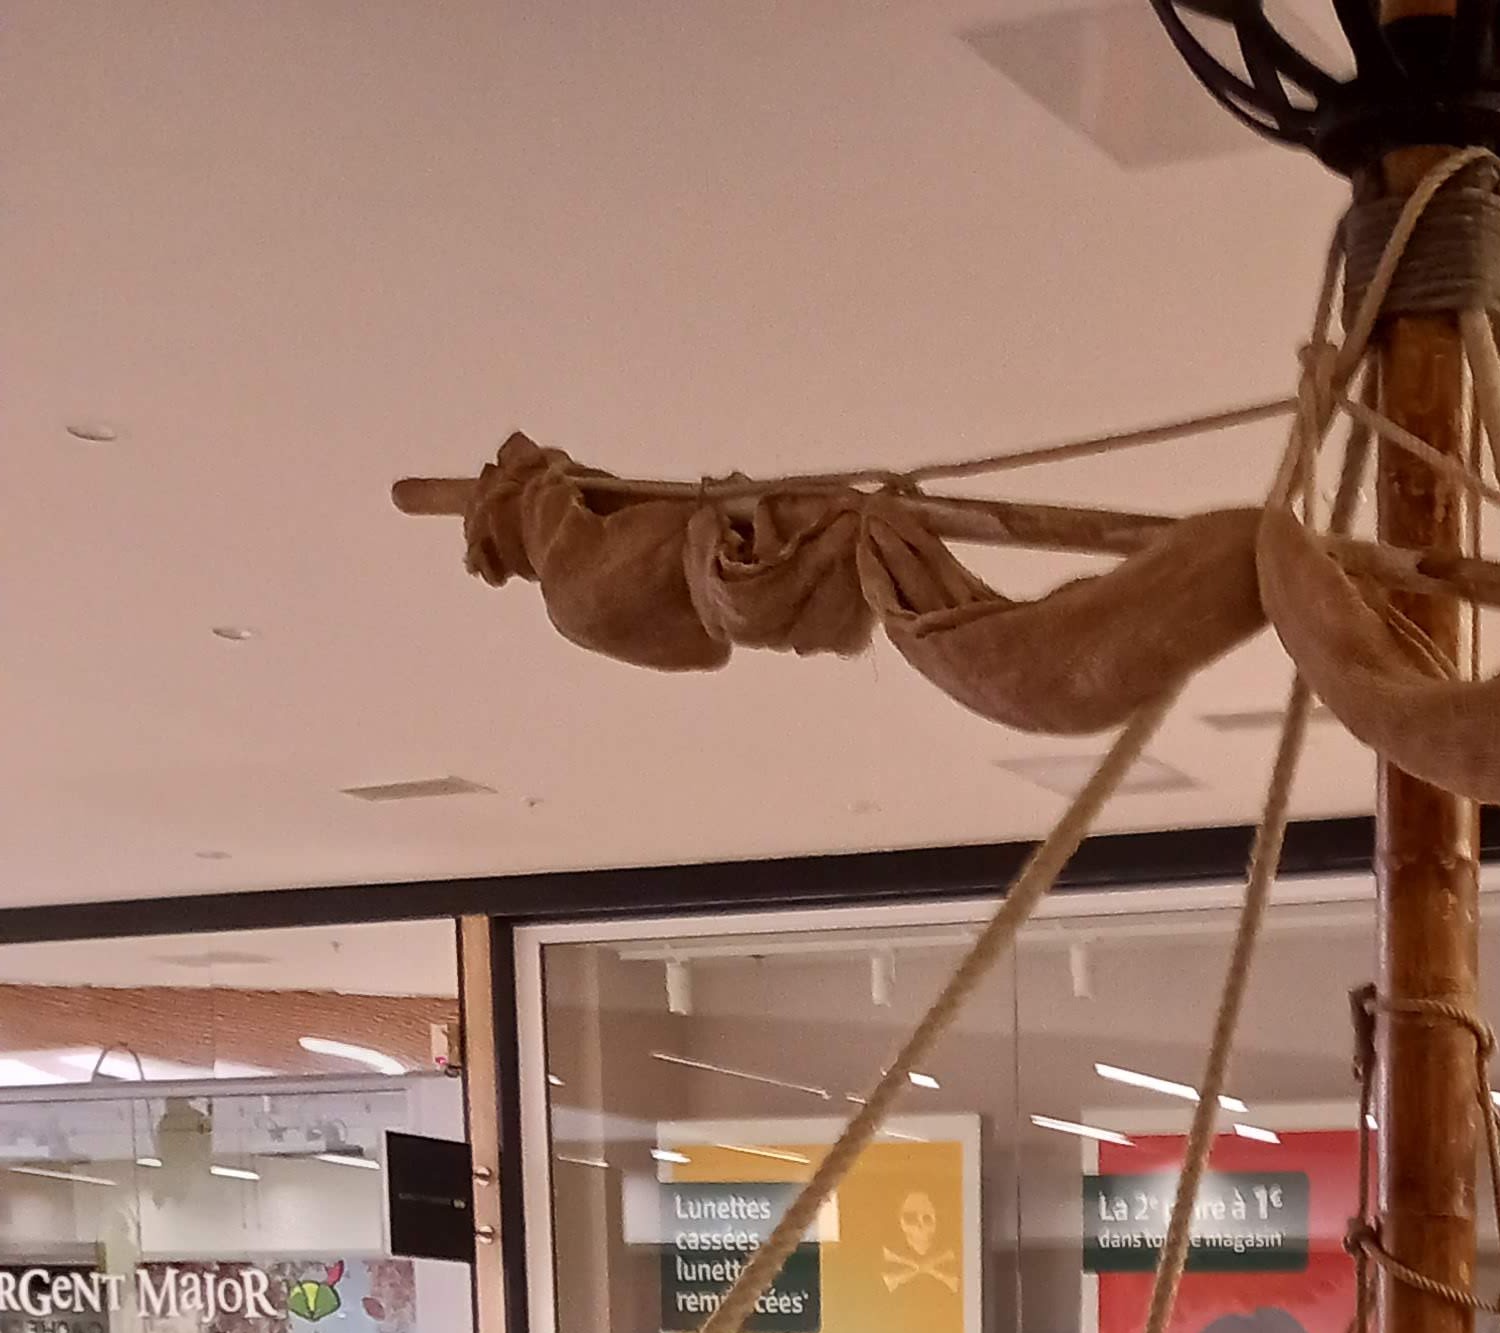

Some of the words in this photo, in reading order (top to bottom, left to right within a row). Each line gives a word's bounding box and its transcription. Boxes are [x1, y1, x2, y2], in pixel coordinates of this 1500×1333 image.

[674, 1192, 771, 1220] Lunettes
[1099, 1191, 1129, 1222] La
[1231, 1187, 1247, 1220] à
[675, 1225, 761, 1251] cassées
[1099, 1231, 1141, 1249] dans
[675, 1255, 744, 1281] lunett
[675, 1288, 809, 1314] remcées
